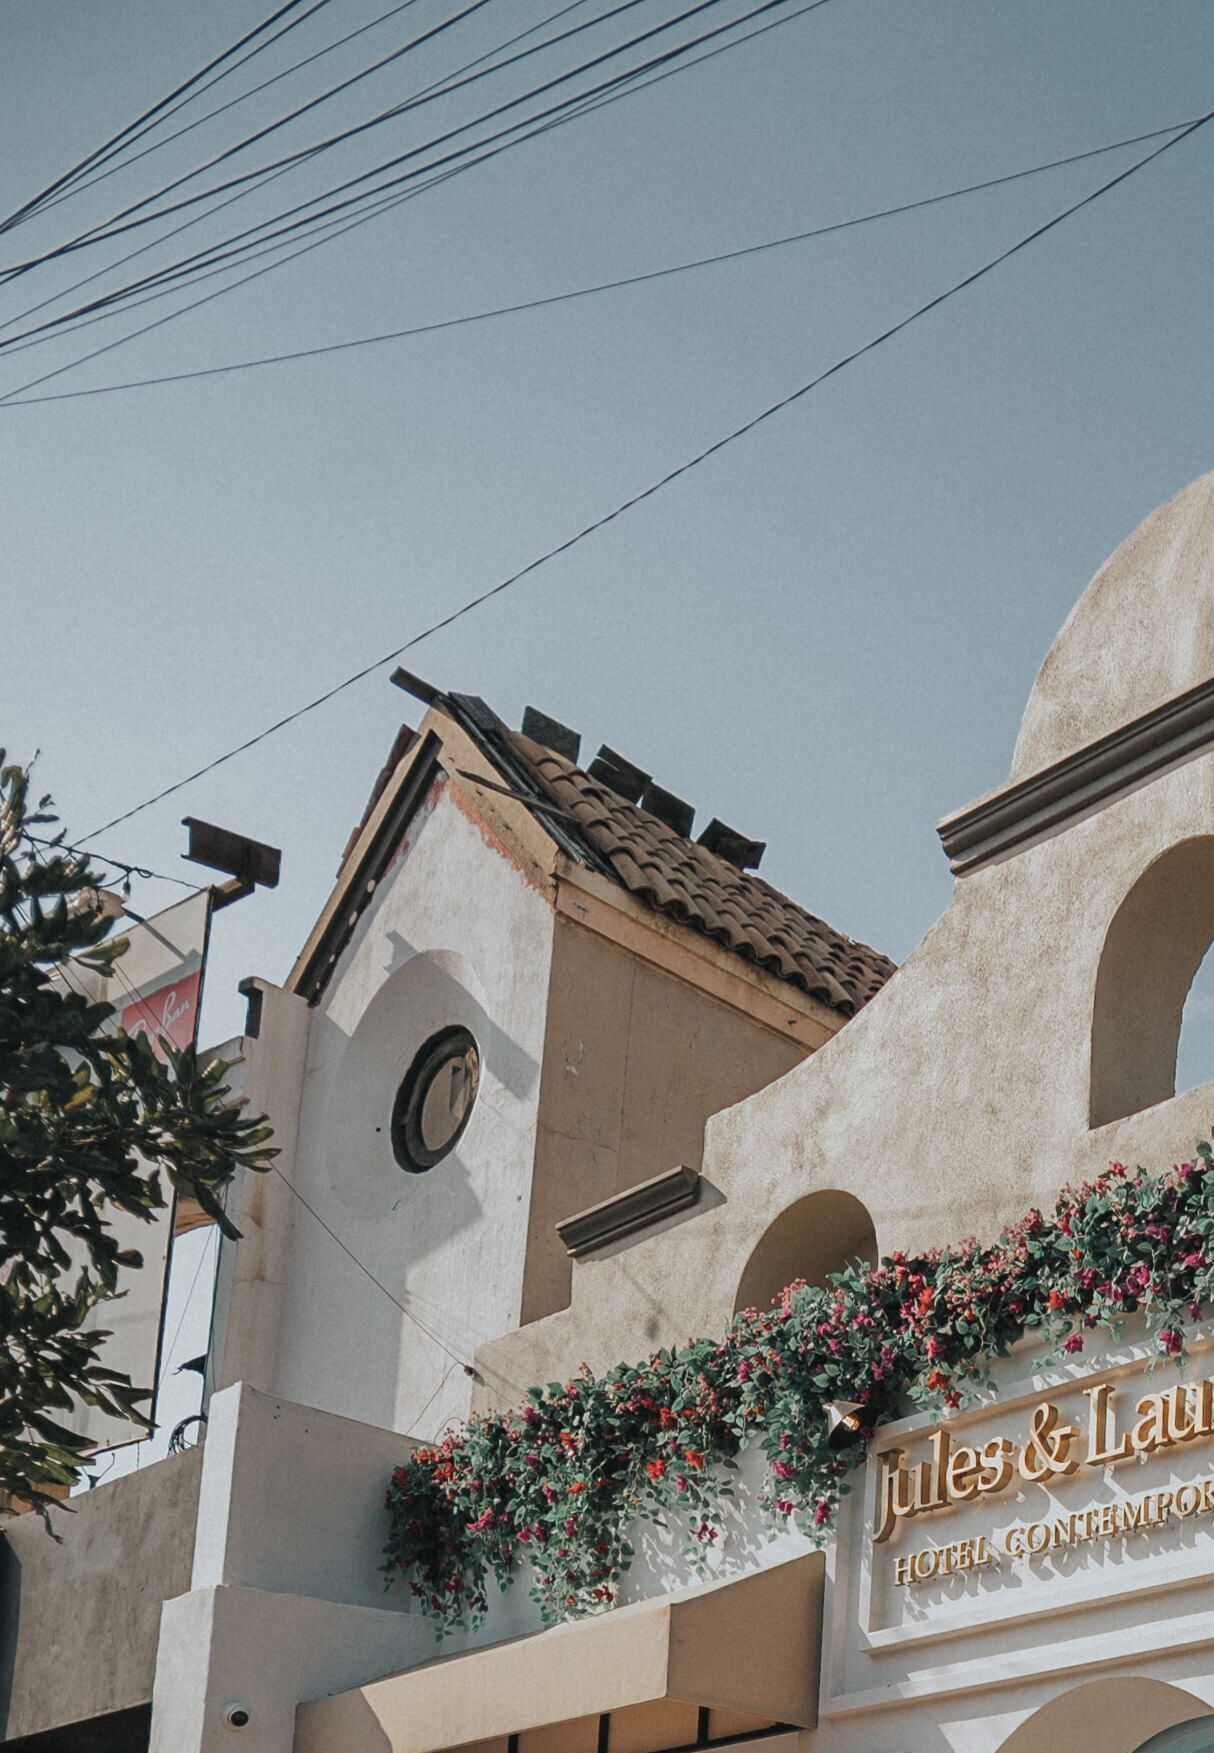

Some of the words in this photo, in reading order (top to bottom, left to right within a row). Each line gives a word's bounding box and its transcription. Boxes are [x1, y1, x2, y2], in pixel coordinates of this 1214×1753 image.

[872, 1429, 1014, 1543] Jules
[1017, 1402, 1081, 1483] &
[893, 1535, 992, 1587] HOTEL
